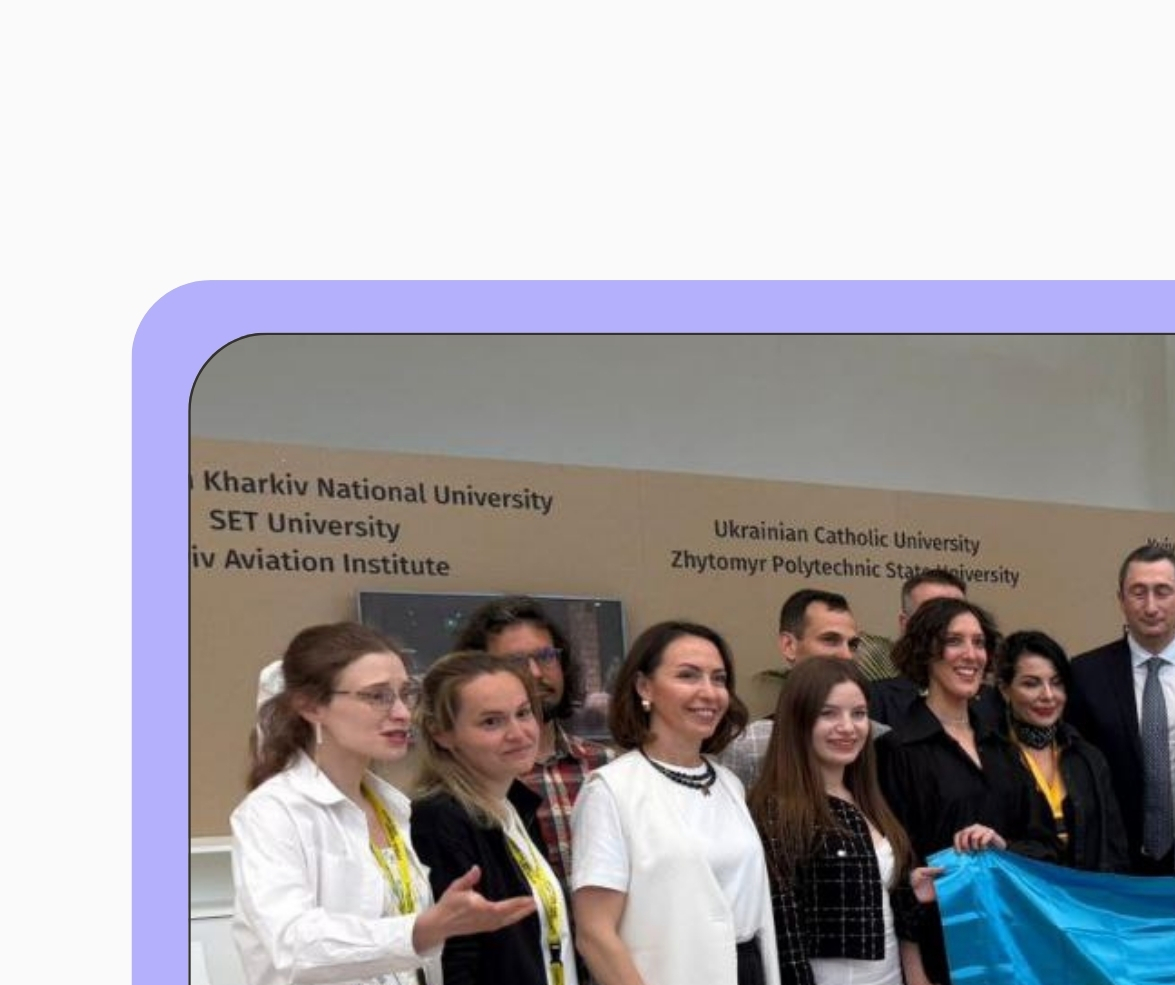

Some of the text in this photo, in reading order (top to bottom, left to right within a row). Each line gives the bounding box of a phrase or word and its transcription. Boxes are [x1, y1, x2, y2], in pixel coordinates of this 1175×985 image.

[203, 470, 308, 496] Kharkiv
[318, 477, 426, 504] National
[434, 484, 554, 515] University
[209, 510, 400, 544] SET University
[714, 519, 980, 557] Ukrainian Catholic University
[225, 547, 335, 573] Aviation
[343, 553, 451, 577] Institute
[671, 550, 768, 575] Zhytomyr
[773, 555, 880, 579] Polytechnic
